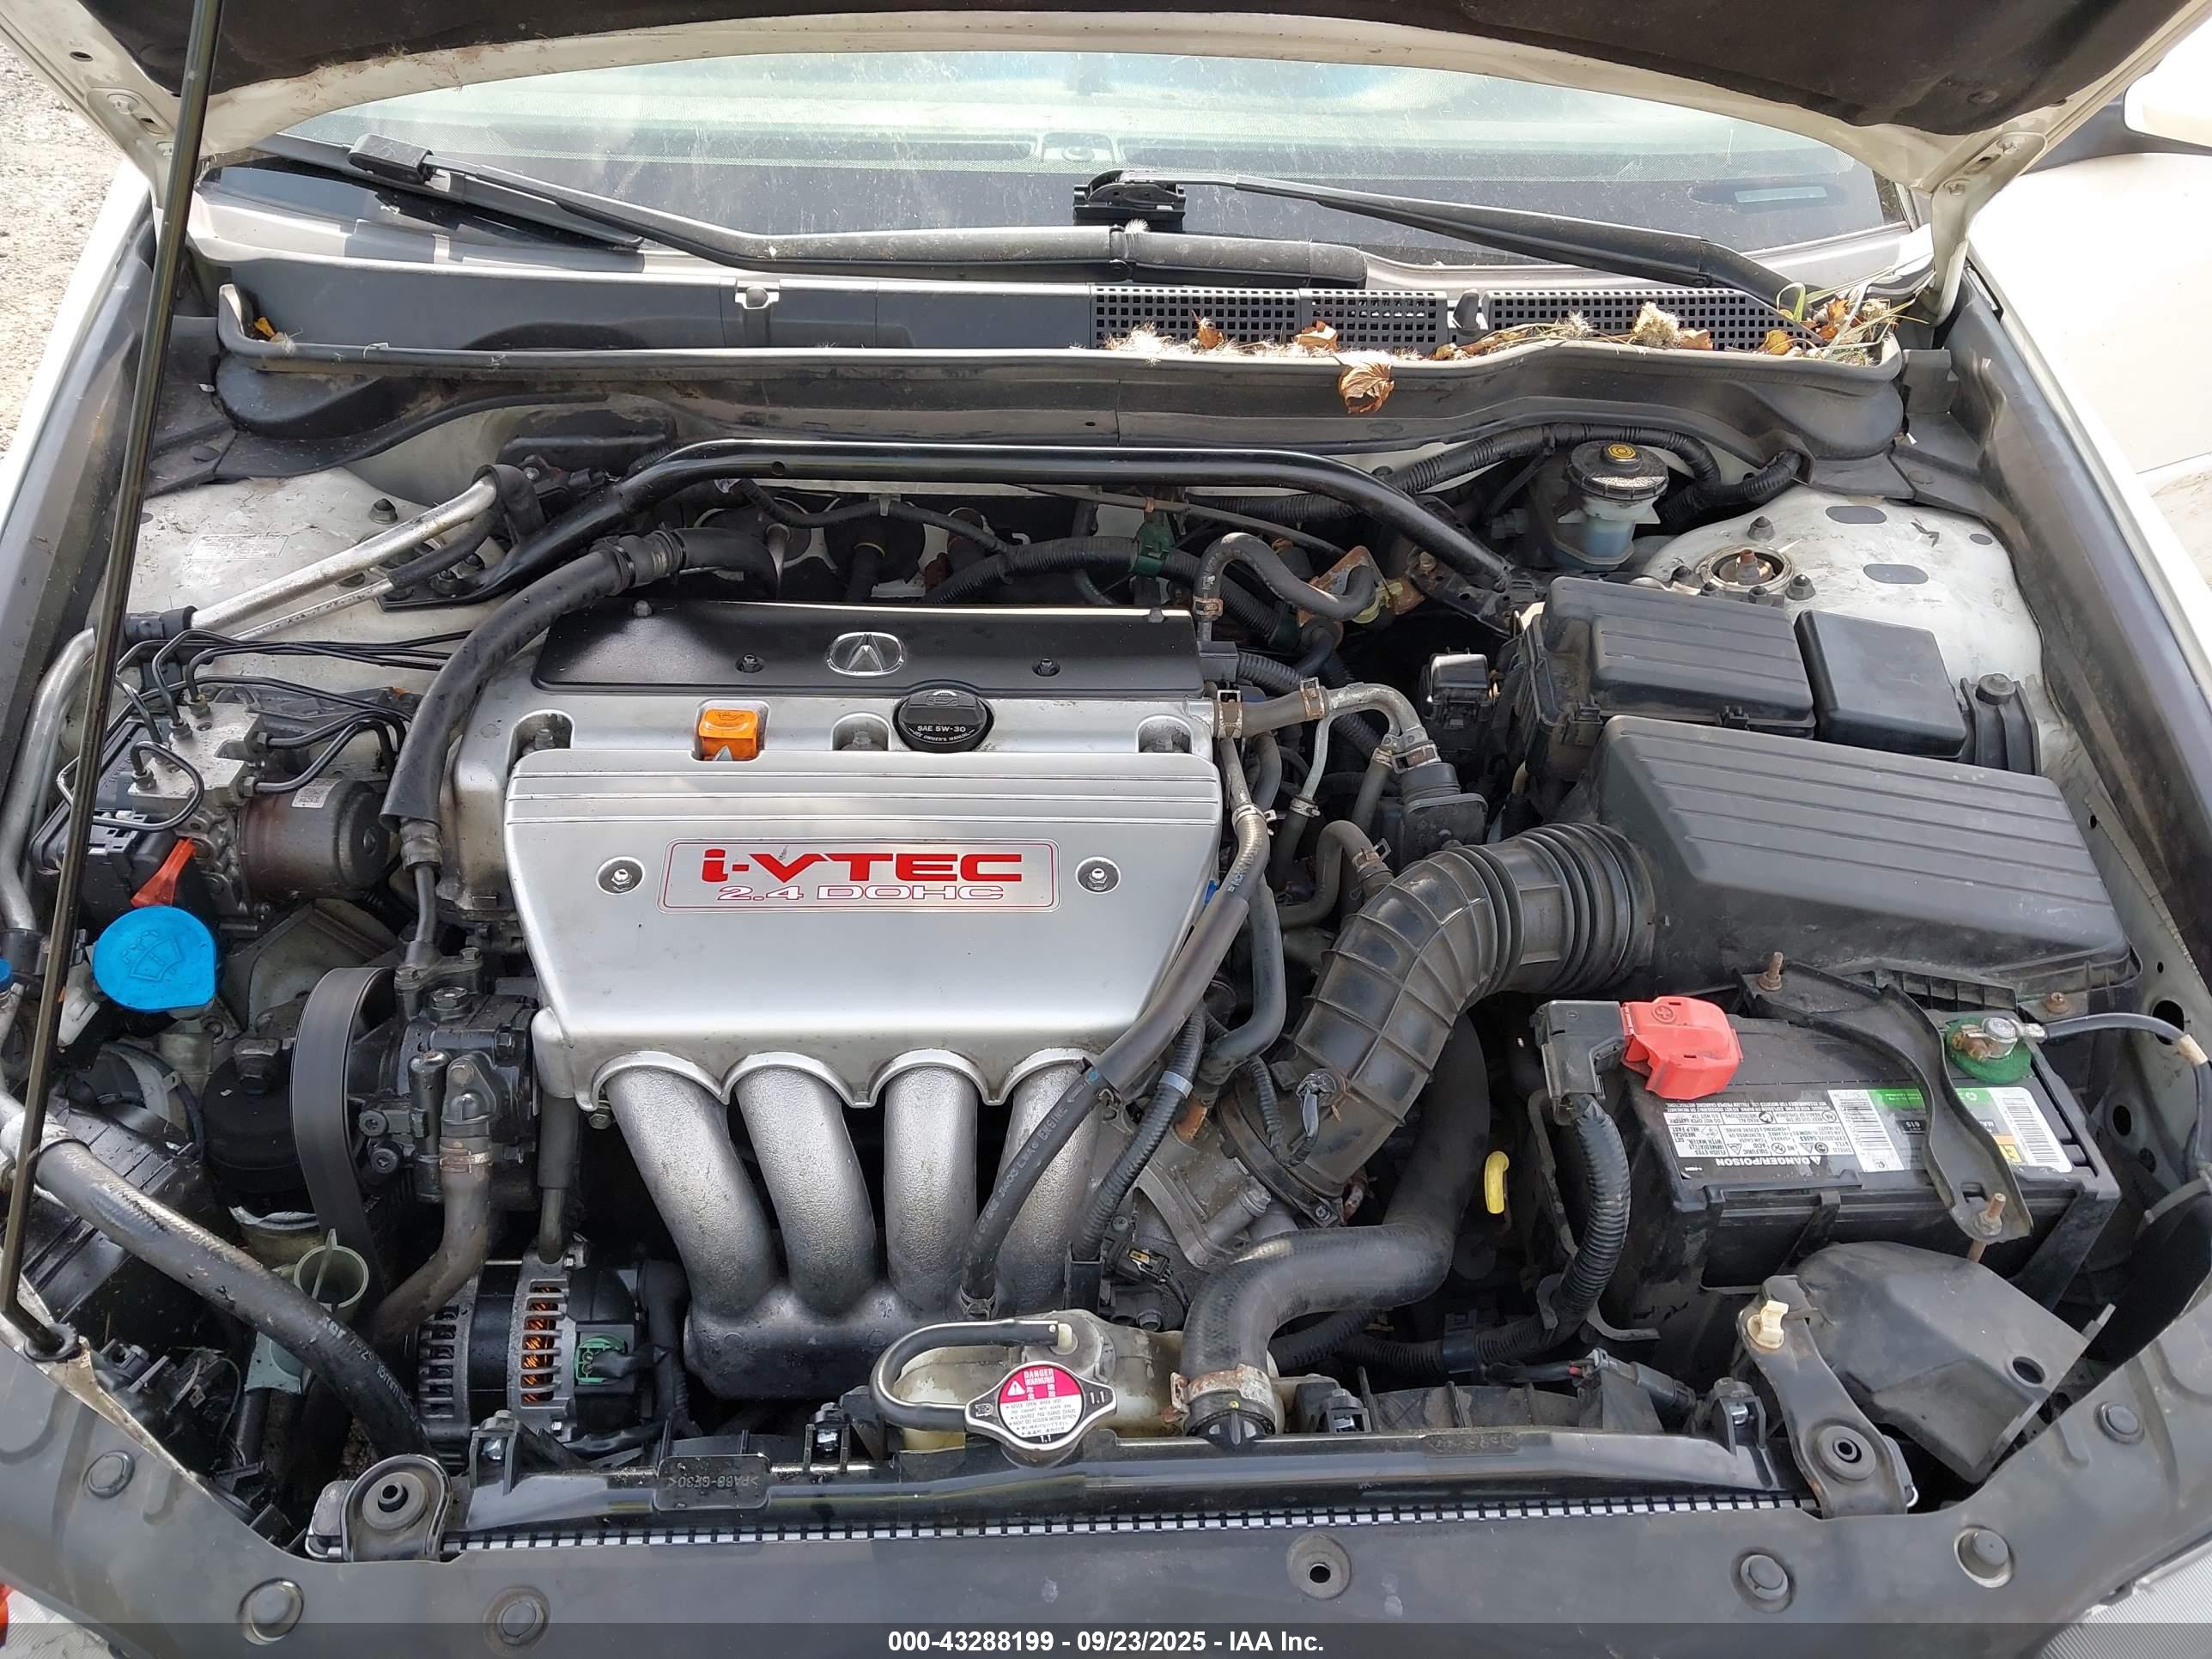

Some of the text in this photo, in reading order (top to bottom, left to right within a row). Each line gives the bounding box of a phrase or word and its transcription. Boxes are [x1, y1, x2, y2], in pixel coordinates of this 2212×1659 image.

[701, 848, 1023, 884] i-VTEC
[716, 885, 1003, 901] 2.4 DOHC
[1715, 1157, 1810, 1166] DANGER/POISON
[1024, 1369, 1054, 1379] DANGER
[1090, 1390, 1105, 1405] 1.1
[1040, 1434, 1052, 1443] 1.1
